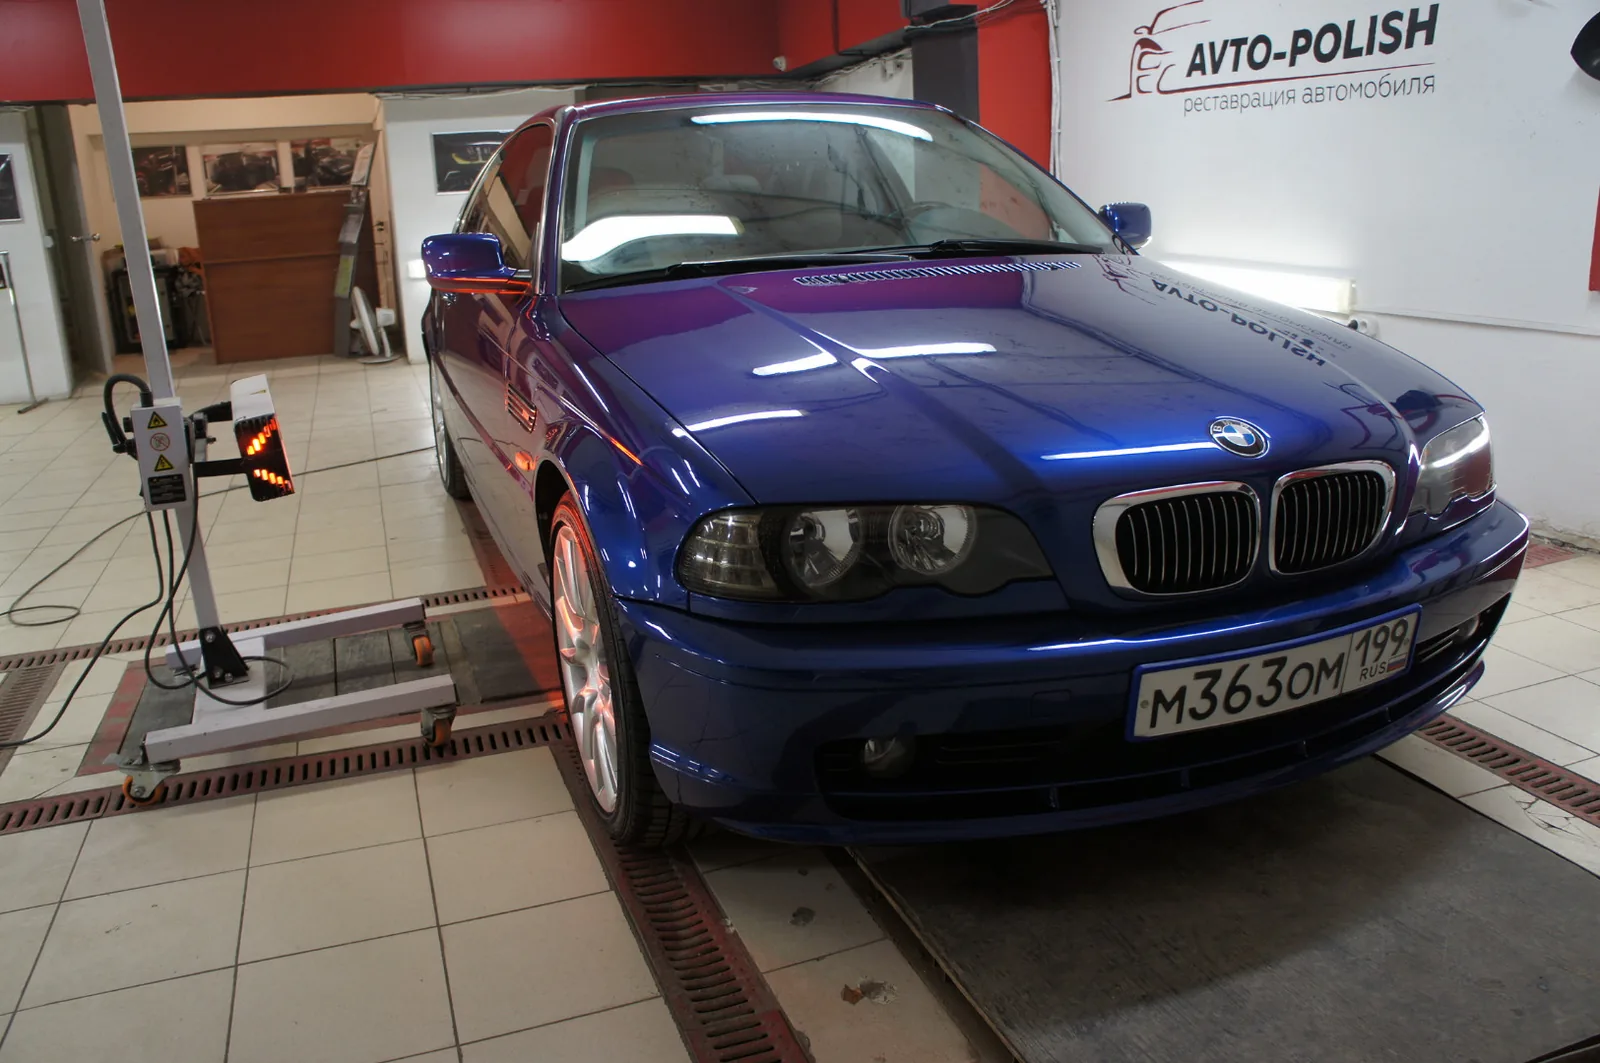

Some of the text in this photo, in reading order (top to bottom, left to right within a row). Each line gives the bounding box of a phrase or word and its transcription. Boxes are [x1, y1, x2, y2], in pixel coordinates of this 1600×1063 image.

[1185, 3, 1440, 78] AVTO-POLISH
[1183, 73, 1437, 117] реставрация автомобиля
[1354, 617, 1410, 668] 199
[1358, 660, 1388, 683] RUS
